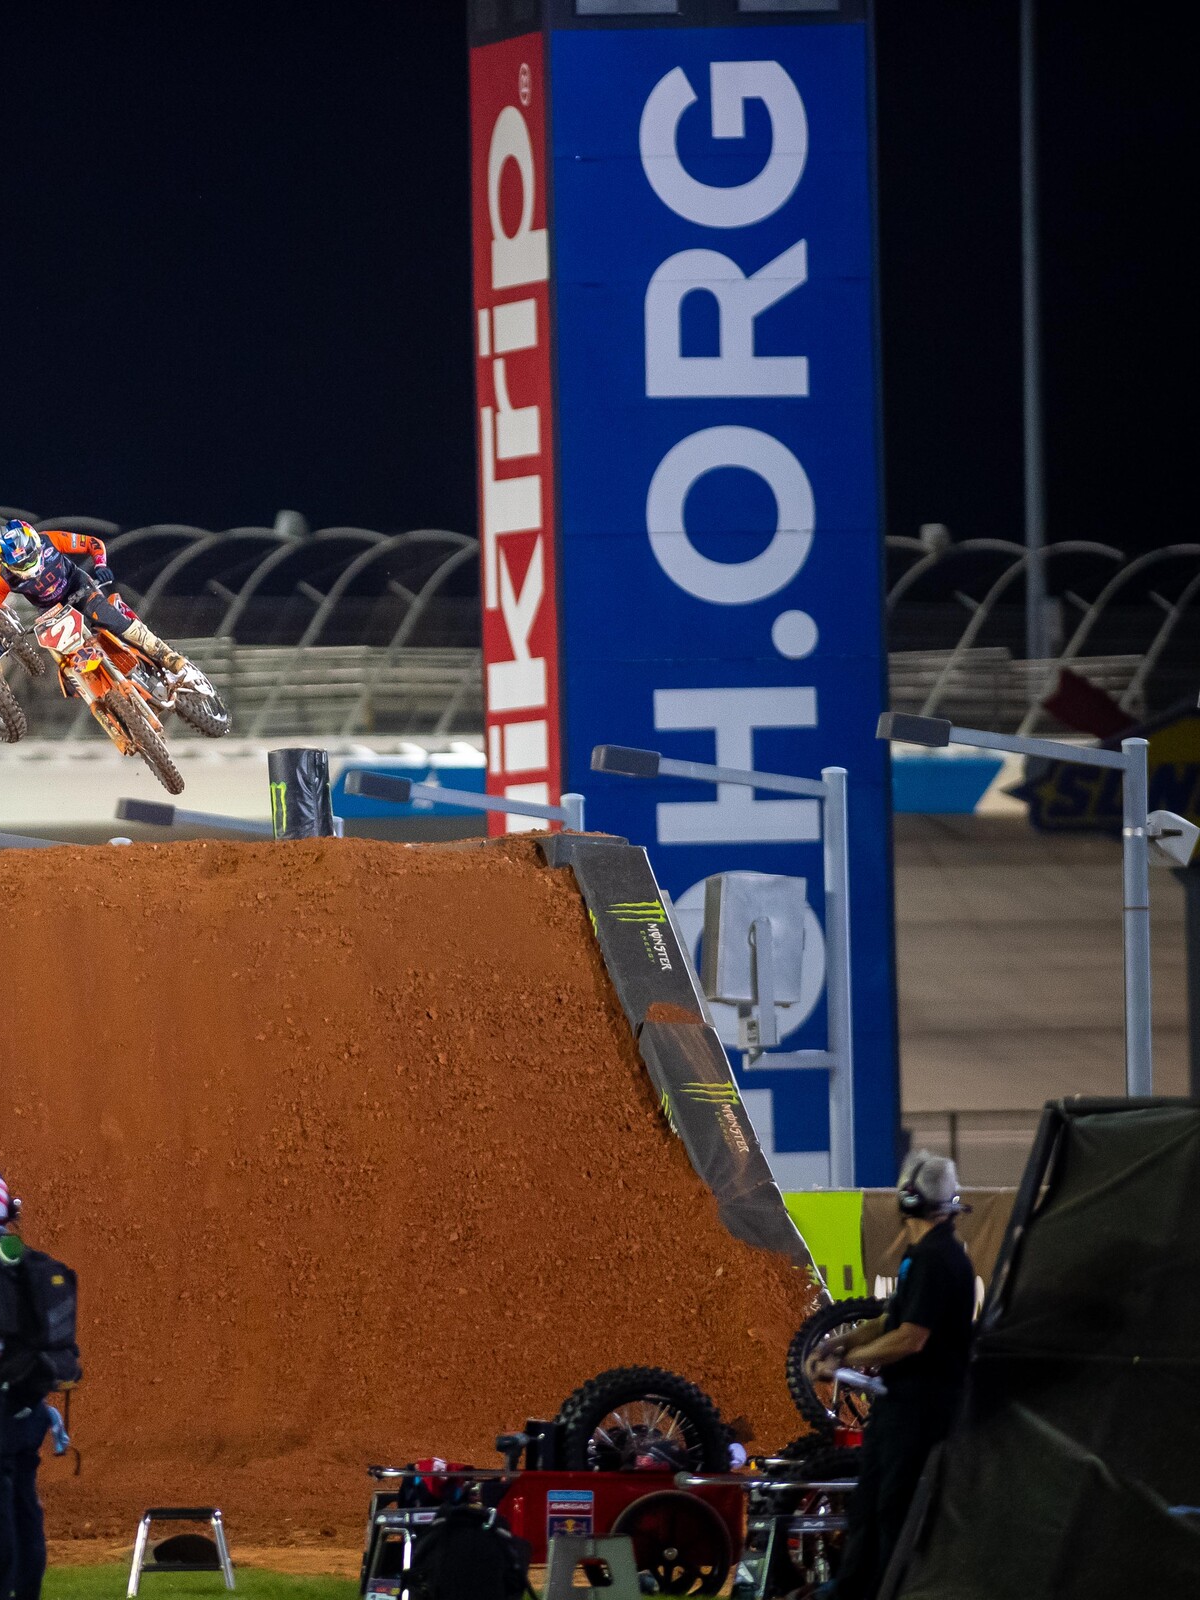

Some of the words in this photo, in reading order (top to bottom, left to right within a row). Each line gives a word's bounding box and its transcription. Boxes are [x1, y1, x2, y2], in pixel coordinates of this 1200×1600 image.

[478, 105, 549, 833] ikTrip
[51, 616, 80, 651] 2
[647, 923, 673, 971] MONSTER
[721, 1103, 749, 1153] MONSTER
